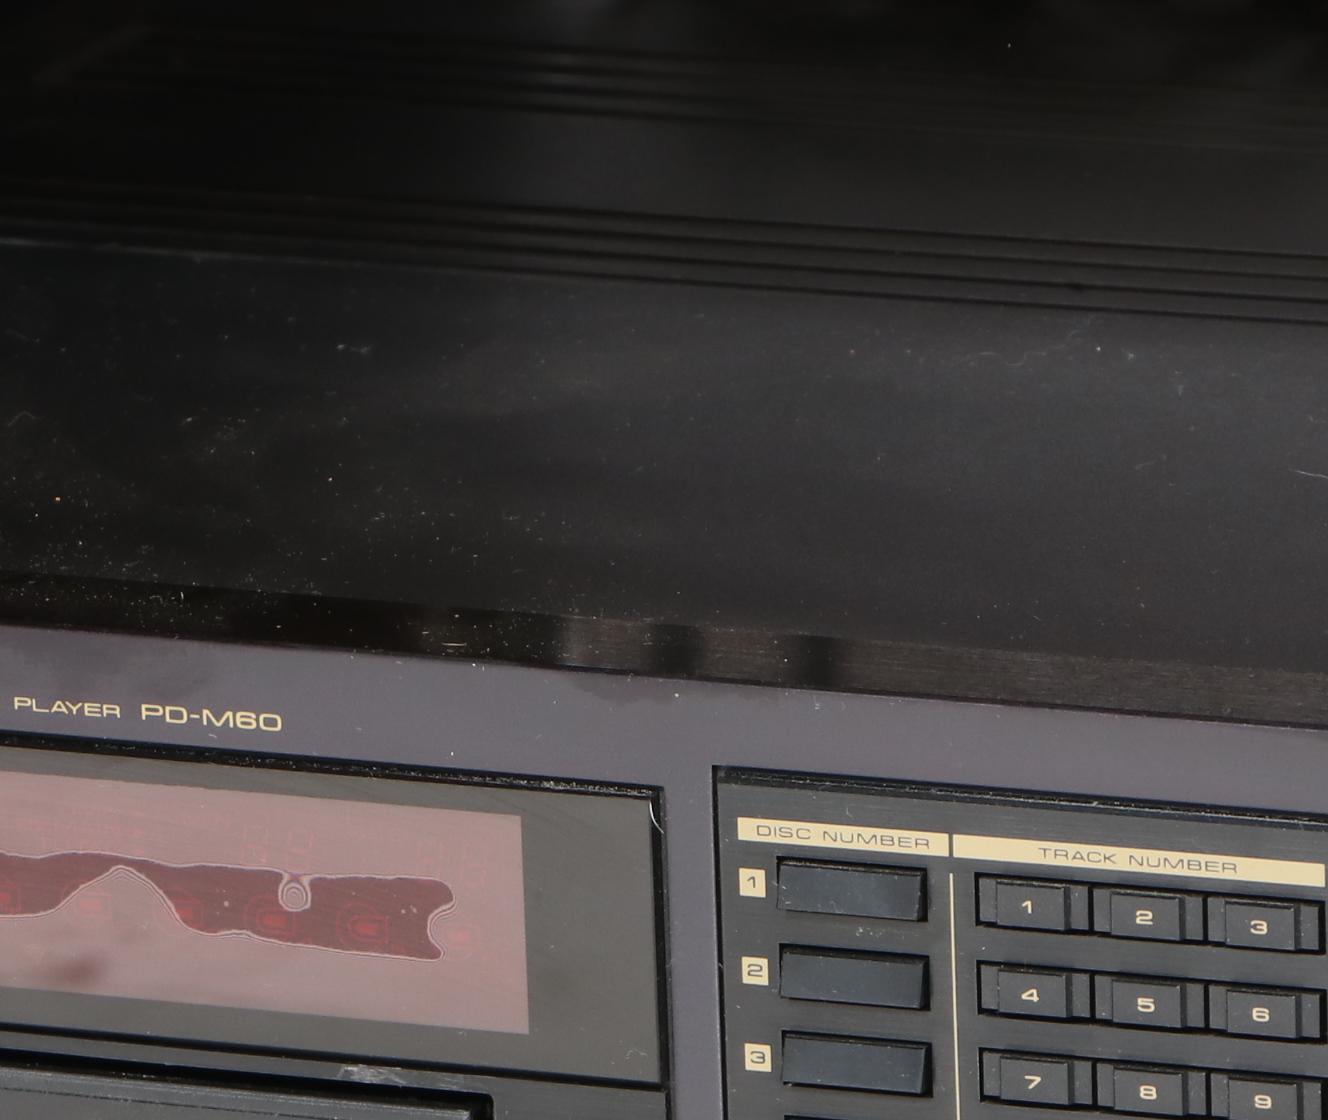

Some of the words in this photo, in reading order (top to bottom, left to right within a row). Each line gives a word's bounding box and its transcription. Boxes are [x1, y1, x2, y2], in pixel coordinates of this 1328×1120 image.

[14, 696, 121, 719] PLAYER
[141, 703, 282, 732] PD-M60
[756, 823, 813, 842] DISC
[822, 830, 932, 850] NUMBER
[1037, 846, 1117, 866] TRACK
[1128, 855, 1239, 876] NUMBER
[747, 876, 756, 889] 1
[1021, 900, 1032, 914] 1
[1135, 910, 1153, 925] 2
[1250, 920, 1268, 935] 3
[747, 963, 763, 978] 2
[1021, 988, 1040, 1003] 4
[1137, 997, 1155, 1013] 5
[1252, 1007, 1270, 1022] 6
[750, 1050, 766, 1065] 3
[1024, 1075, 1042, 1090] 7
[1139, 1085, 1157, 1100] 8
[1254, 1094, 1272, 1109] 9
